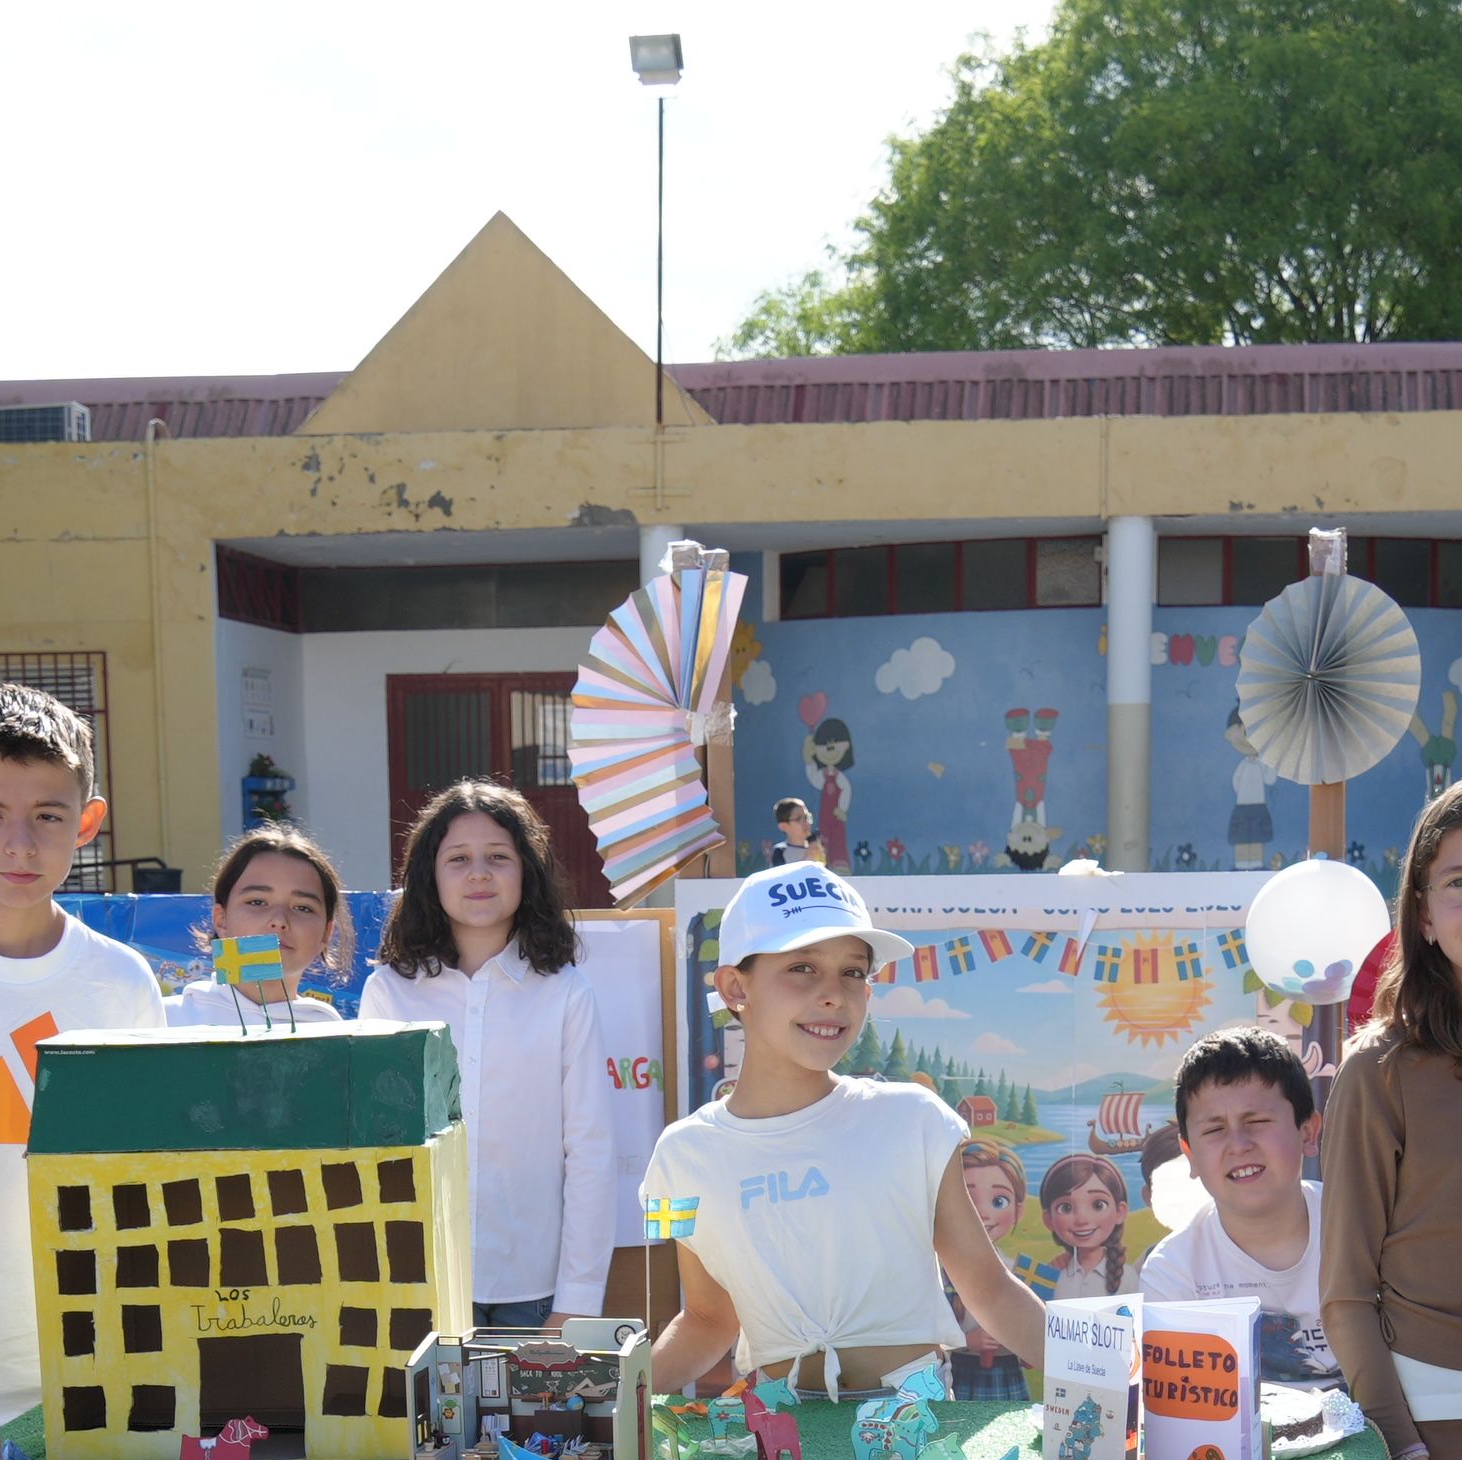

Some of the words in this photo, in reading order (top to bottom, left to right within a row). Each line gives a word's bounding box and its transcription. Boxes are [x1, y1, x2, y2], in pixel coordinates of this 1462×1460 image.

[740, 1166, 830, 1210] FILA
[215, 1289, 250, 1301] LOS
[1048, 1315, 1089, 1345] KALMAR
[1091, 1323, 1125, 1351] SLOTT
[1143, 1343, 1236, 1373] FOLLETO
